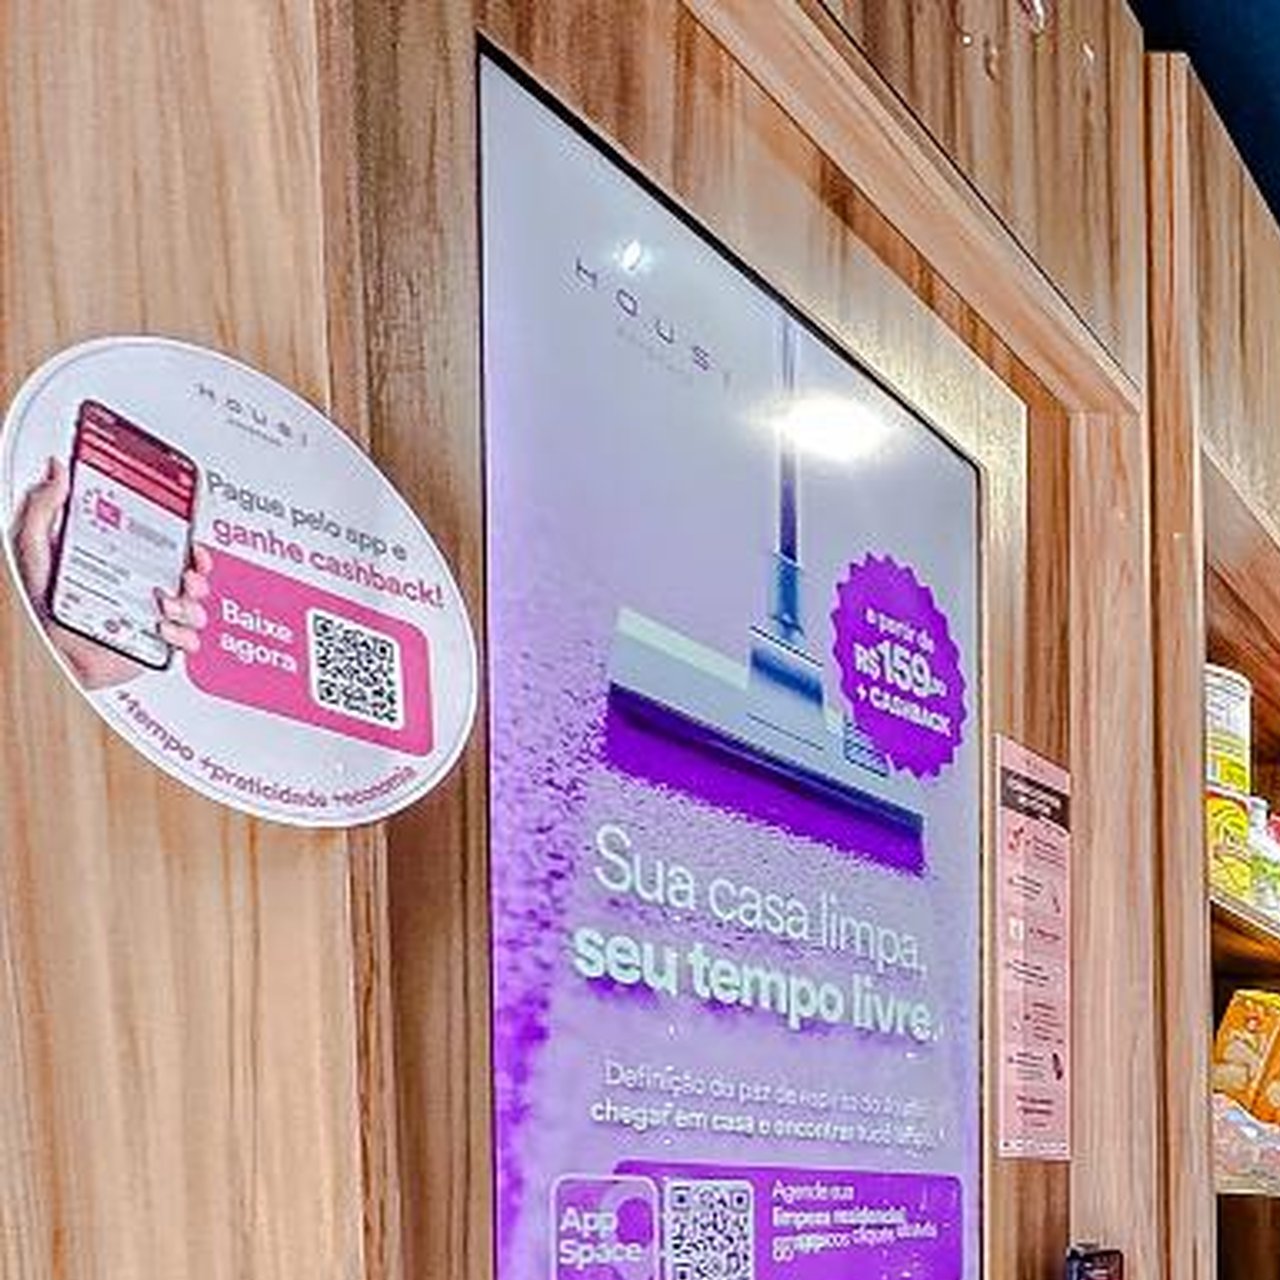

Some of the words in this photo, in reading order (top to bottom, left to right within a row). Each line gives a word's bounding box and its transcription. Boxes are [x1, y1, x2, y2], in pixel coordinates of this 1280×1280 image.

[207, 471, 286, 519] Pague
[290, 505, 343, 540] pelo
[346, 527, 390, 562] app
[393, 543, 407, 562] e
[212, 516, 303, 562] ganhe
[308, 547, 446, 609] cashback!
[220, 598, 295, 643] Baixe
[219, 632, 298, 674] agora
[595, 822, 696, 913] Sua
[706, 877, 810, 941] casa
[572, 925, 678, 998] seu
[687, 942, 845, 1030] tempo
[850, 970, 940, 1042] livre.
[589, 1098, 671, 1131] chegar
[675, 1108, 706, 1129] em
[709, 1113, 754, 1137] casa
[558, 1207, 619, 1237] App
[558, 1238, 645, 1269] Space
